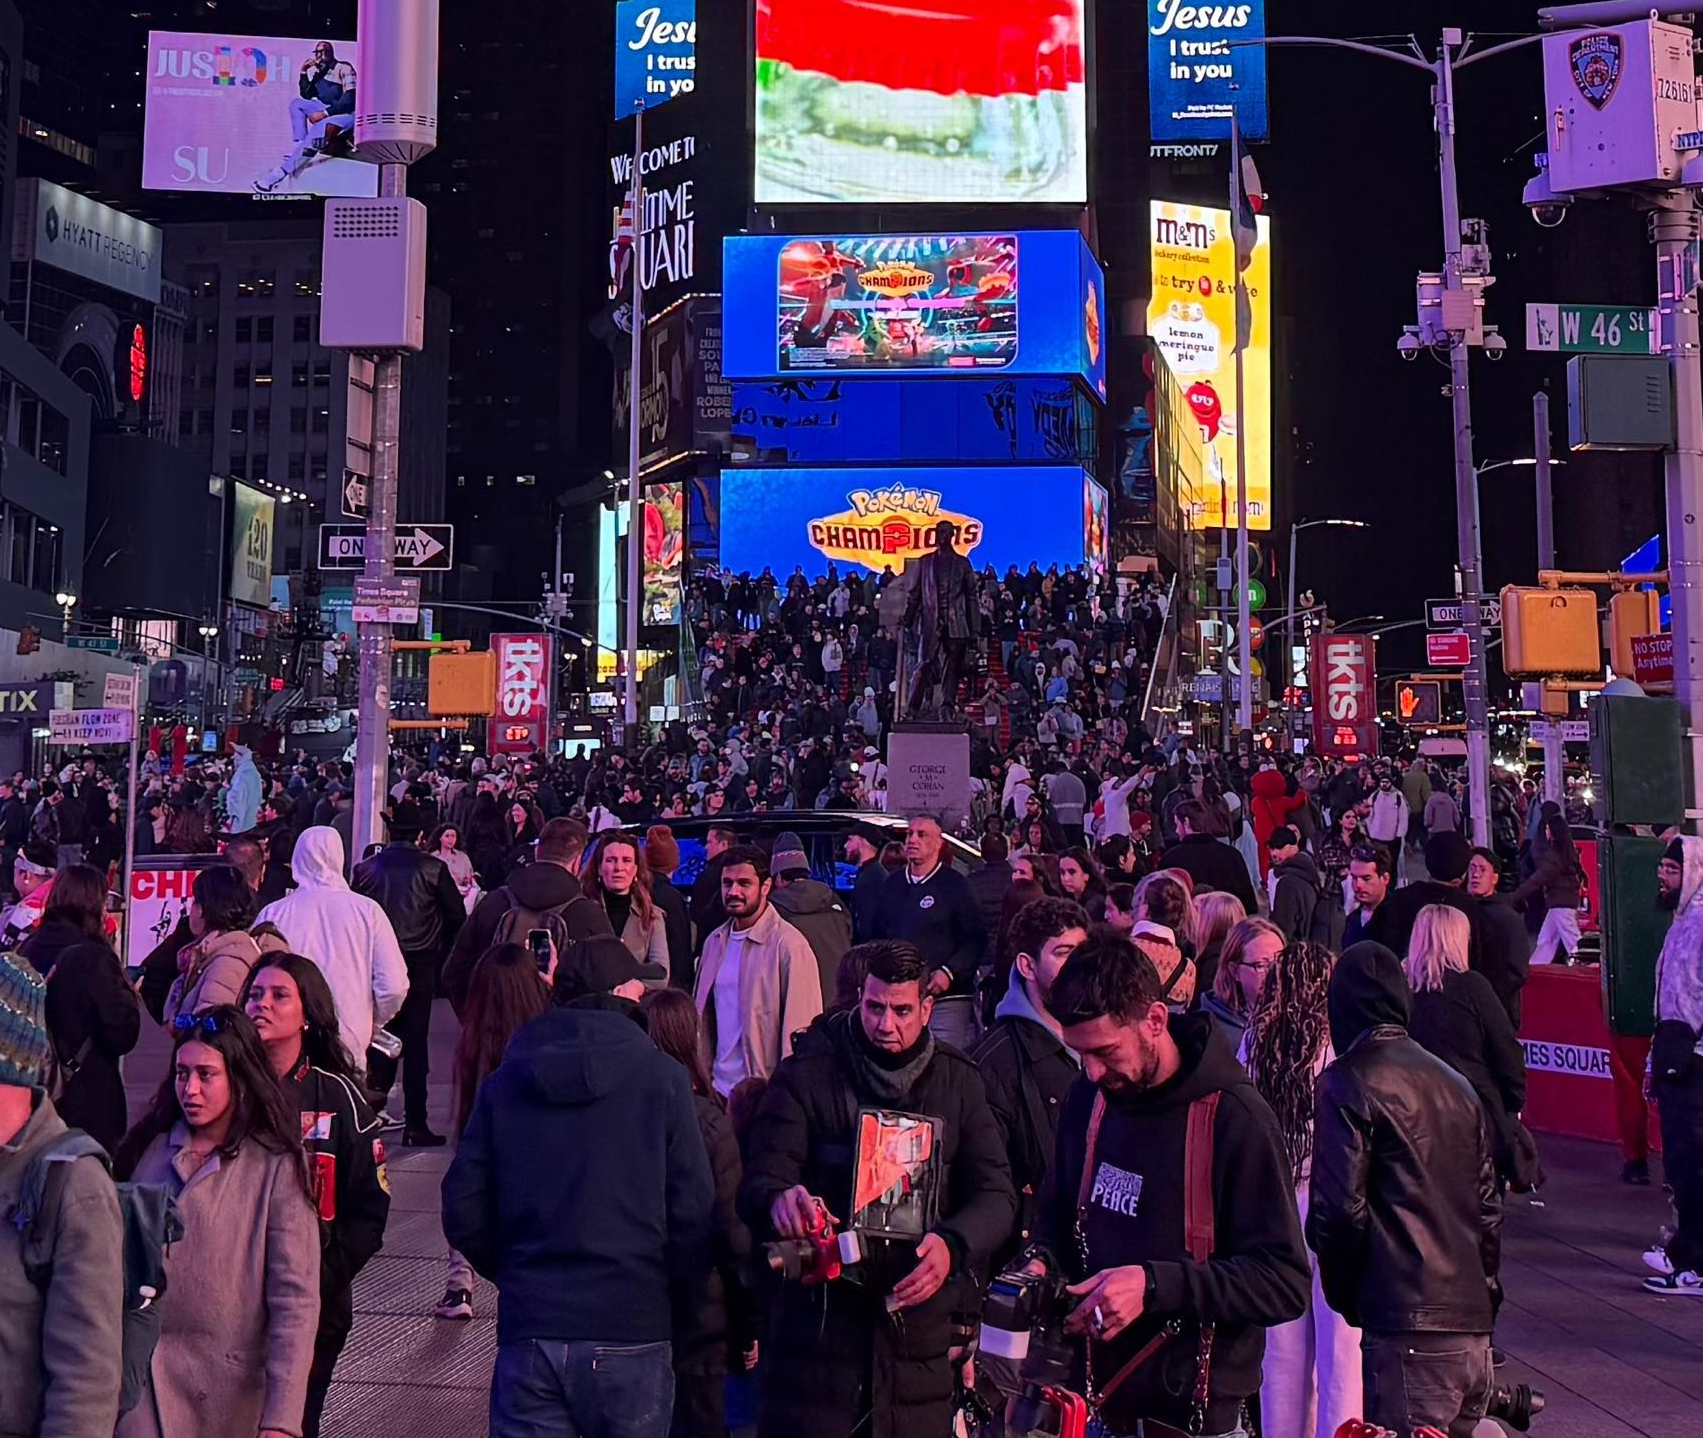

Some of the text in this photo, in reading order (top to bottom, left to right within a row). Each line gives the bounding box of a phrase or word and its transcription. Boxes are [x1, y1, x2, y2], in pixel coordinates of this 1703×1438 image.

[1170, 40, 1231, 56] I trust
[1170, 62, 1233, 84] in you
[646, 76, 666, 93] in
[1658, 77, 1693, 104] 726161
[63, 220, 155, 273] HYATT REGENCY
[1172, 276, 1195, 293] try
[1169, 326, 1204, 339] lemon
[1562, 310, 1644, 347] W 46 St
[1178, 352, 1195, 363] pie
[1439, 608, 1463, 620] ONE
[1634, 642, 1648, 654] NO
[503, 638, 540, 719] tkts
[1325, 640, 1362, 720] tkts
[1090, 1183, 1140, 1218] PEACE
